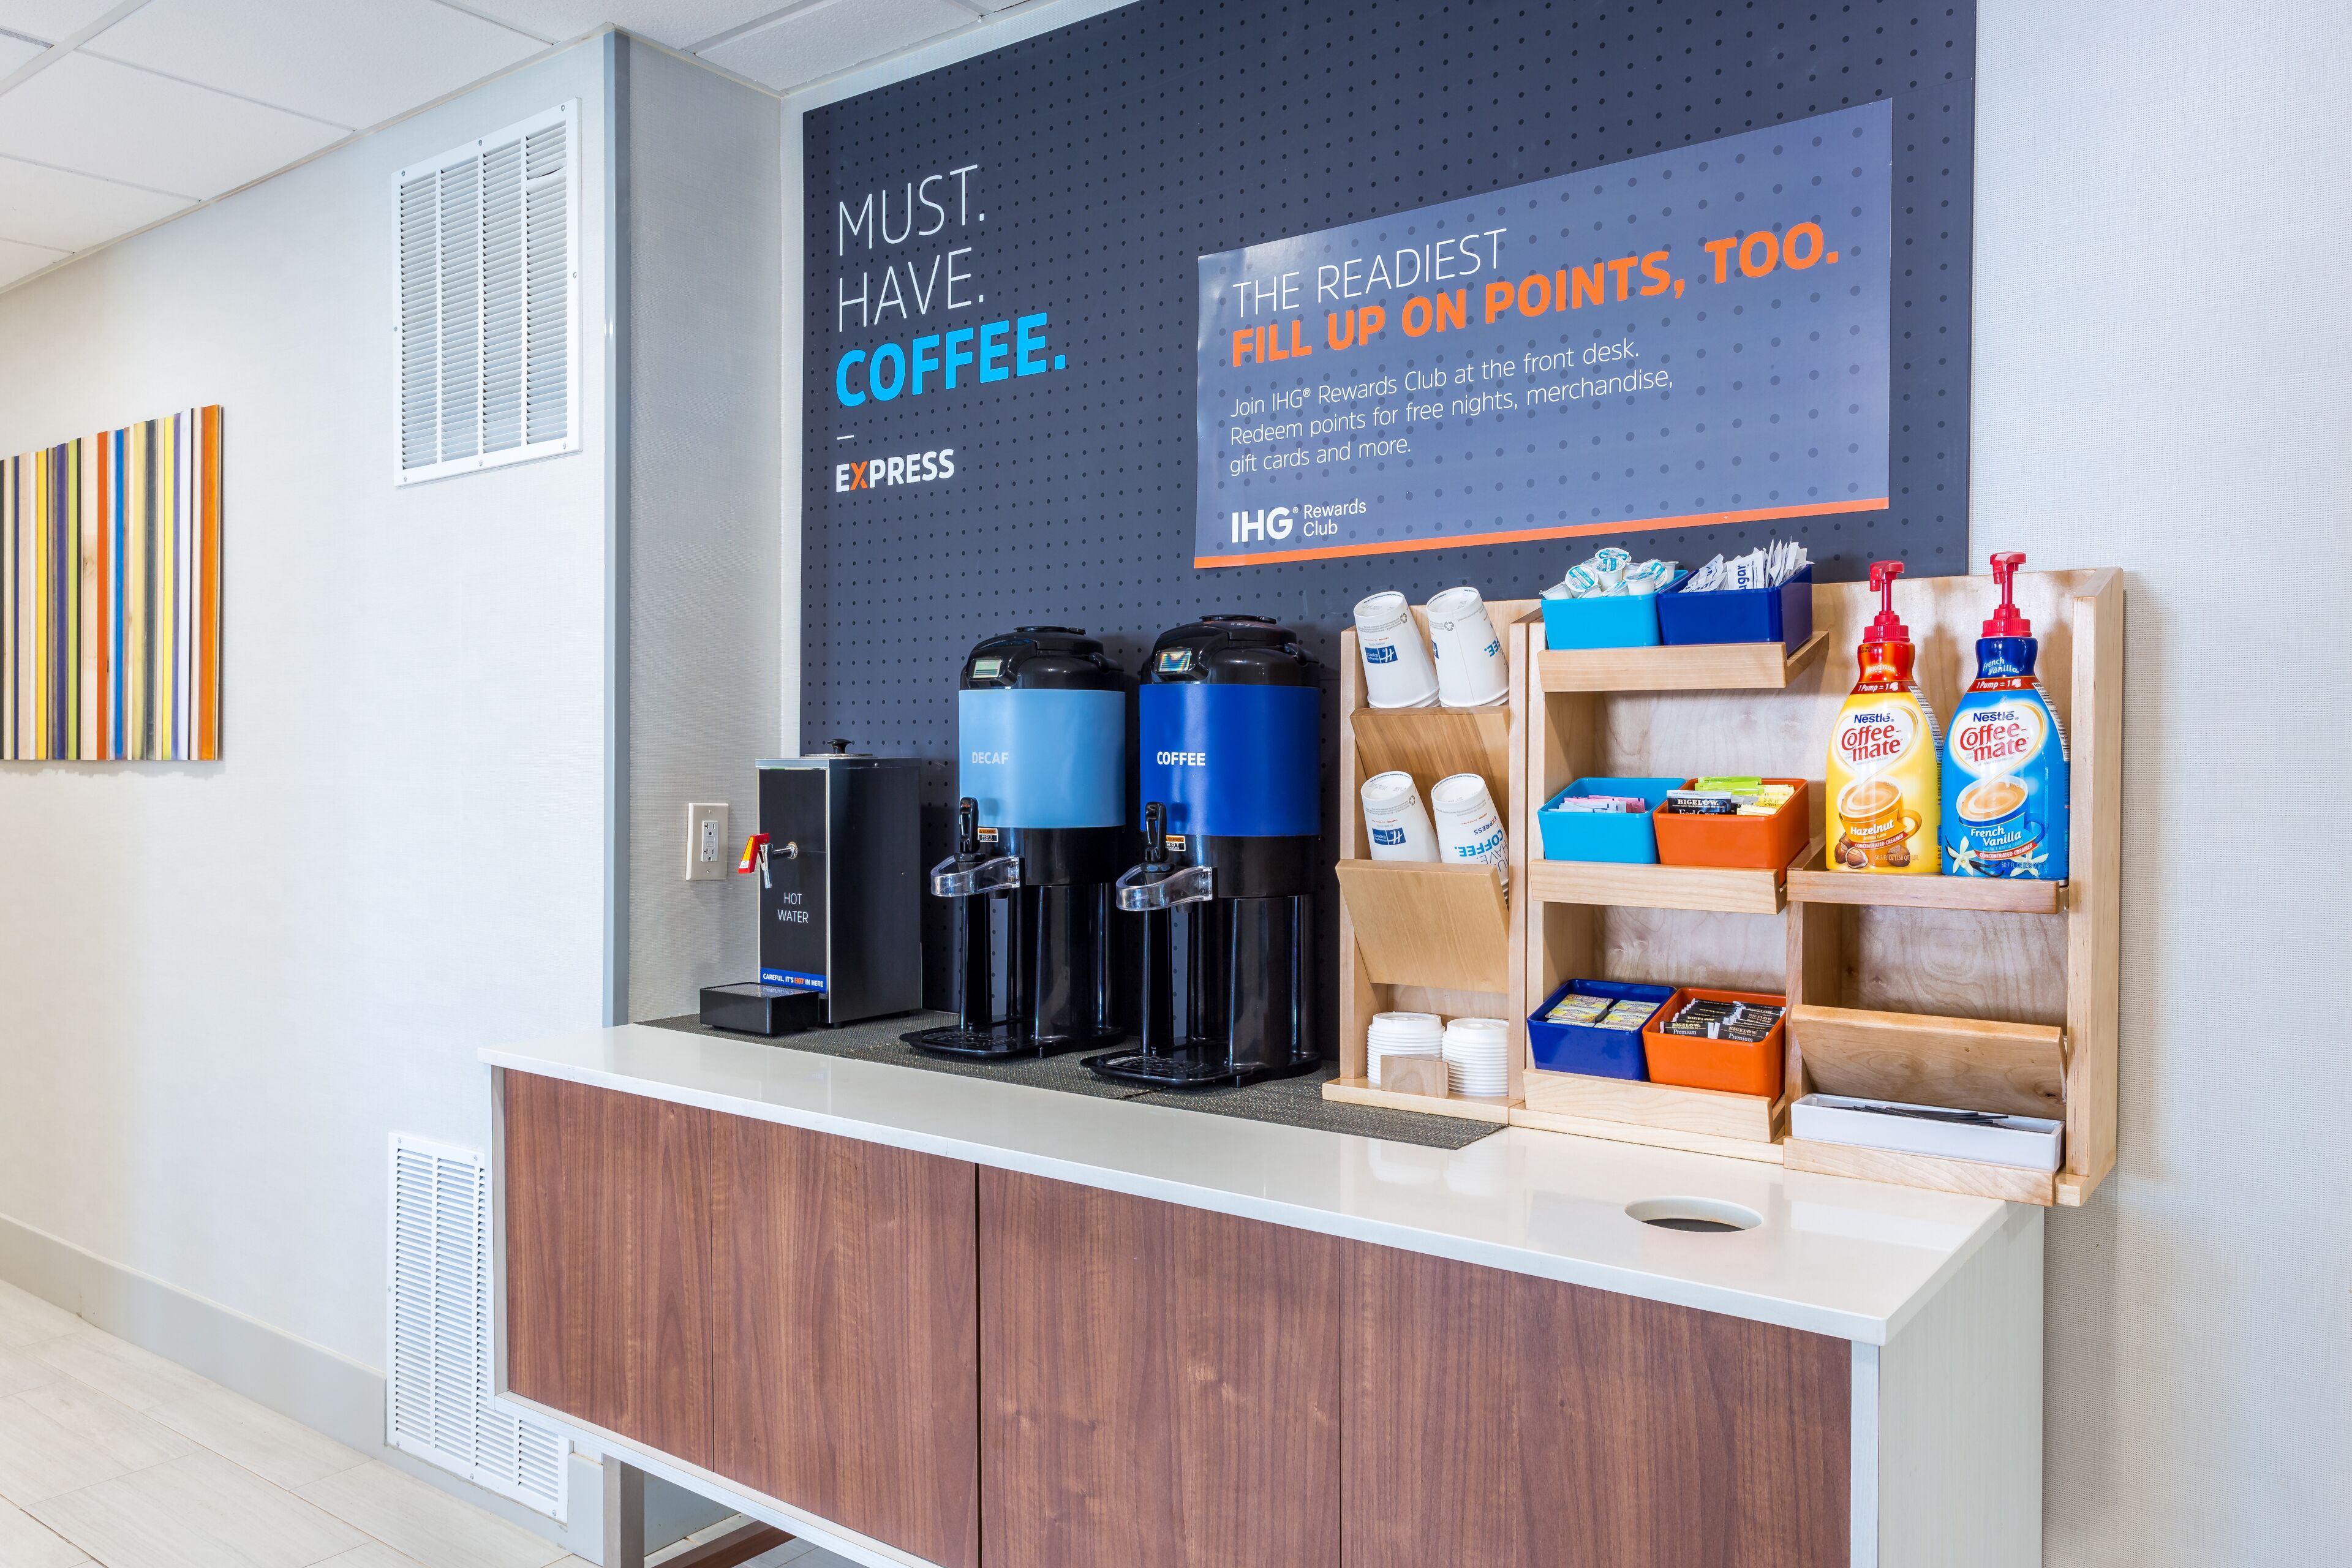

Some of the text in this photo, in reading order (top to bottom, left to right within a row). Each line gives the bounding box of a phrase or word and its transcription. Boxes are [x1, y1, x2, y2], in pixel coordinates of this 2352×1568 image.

[839, 164, 984, 256] MUST.
[1232, 228, 1507, 318] THE READIEST
[839, 247, 984, 332] HAVE.
[1233, 222, 1839, 368] FILL UP ON POINTS, TOO.
[835, 312, 1066, 407] COFFEE.
[1231, 398, 1265, 418] Join
[1319, 375, 1397, 404] Rewards
[1404, 368, 1447, 391] Club
[1454, 364, 1474, 385] at
[1481, 359, 1515, 380] the
[1523, 347, 1575, 374] front
[1583, 337, 1639, 364] desk.
[1231, 369, 1673, 445] Redeem points for free nights, merchandise,
[1230, 438, 1411, 477] gift cards and more.
[836, 448, 955, 492] EXPRESS
[1303, 498, 1366, 519] Rewards
[1303, 519, 1338, 537] Club
[1737, 565, 1750, 589] ugar
[1983, 657, 2005, 671] French
[1980, 680, 1998, 689] Pump
[972, 752, 1009, 764] DECAF
[1157, 751, 1205, 766] COFFEE
[1852, 739, 1901, 761] mate
[1973, 738, 2027, 762] mate
[1474, 815, 1498, 835] EXPRESS
[1850, 819, 1894, 835] Hazelnut
[1970, 825, 2005, 837] French
[1454, 829, 1504, 857] COFFEE.
[1885, 833, 1904, 845] CREAMER
[1983, 831, 2022, 846] Vanilla
[2013, 843, 2033, 855] CREAMER
[784, 892, 802, 905] HOT
[778, 909, 809, 923] WATER
[763, 973, 784, 982] CAREFUL,
[1728, 1033, 1753, 1042] Premium
